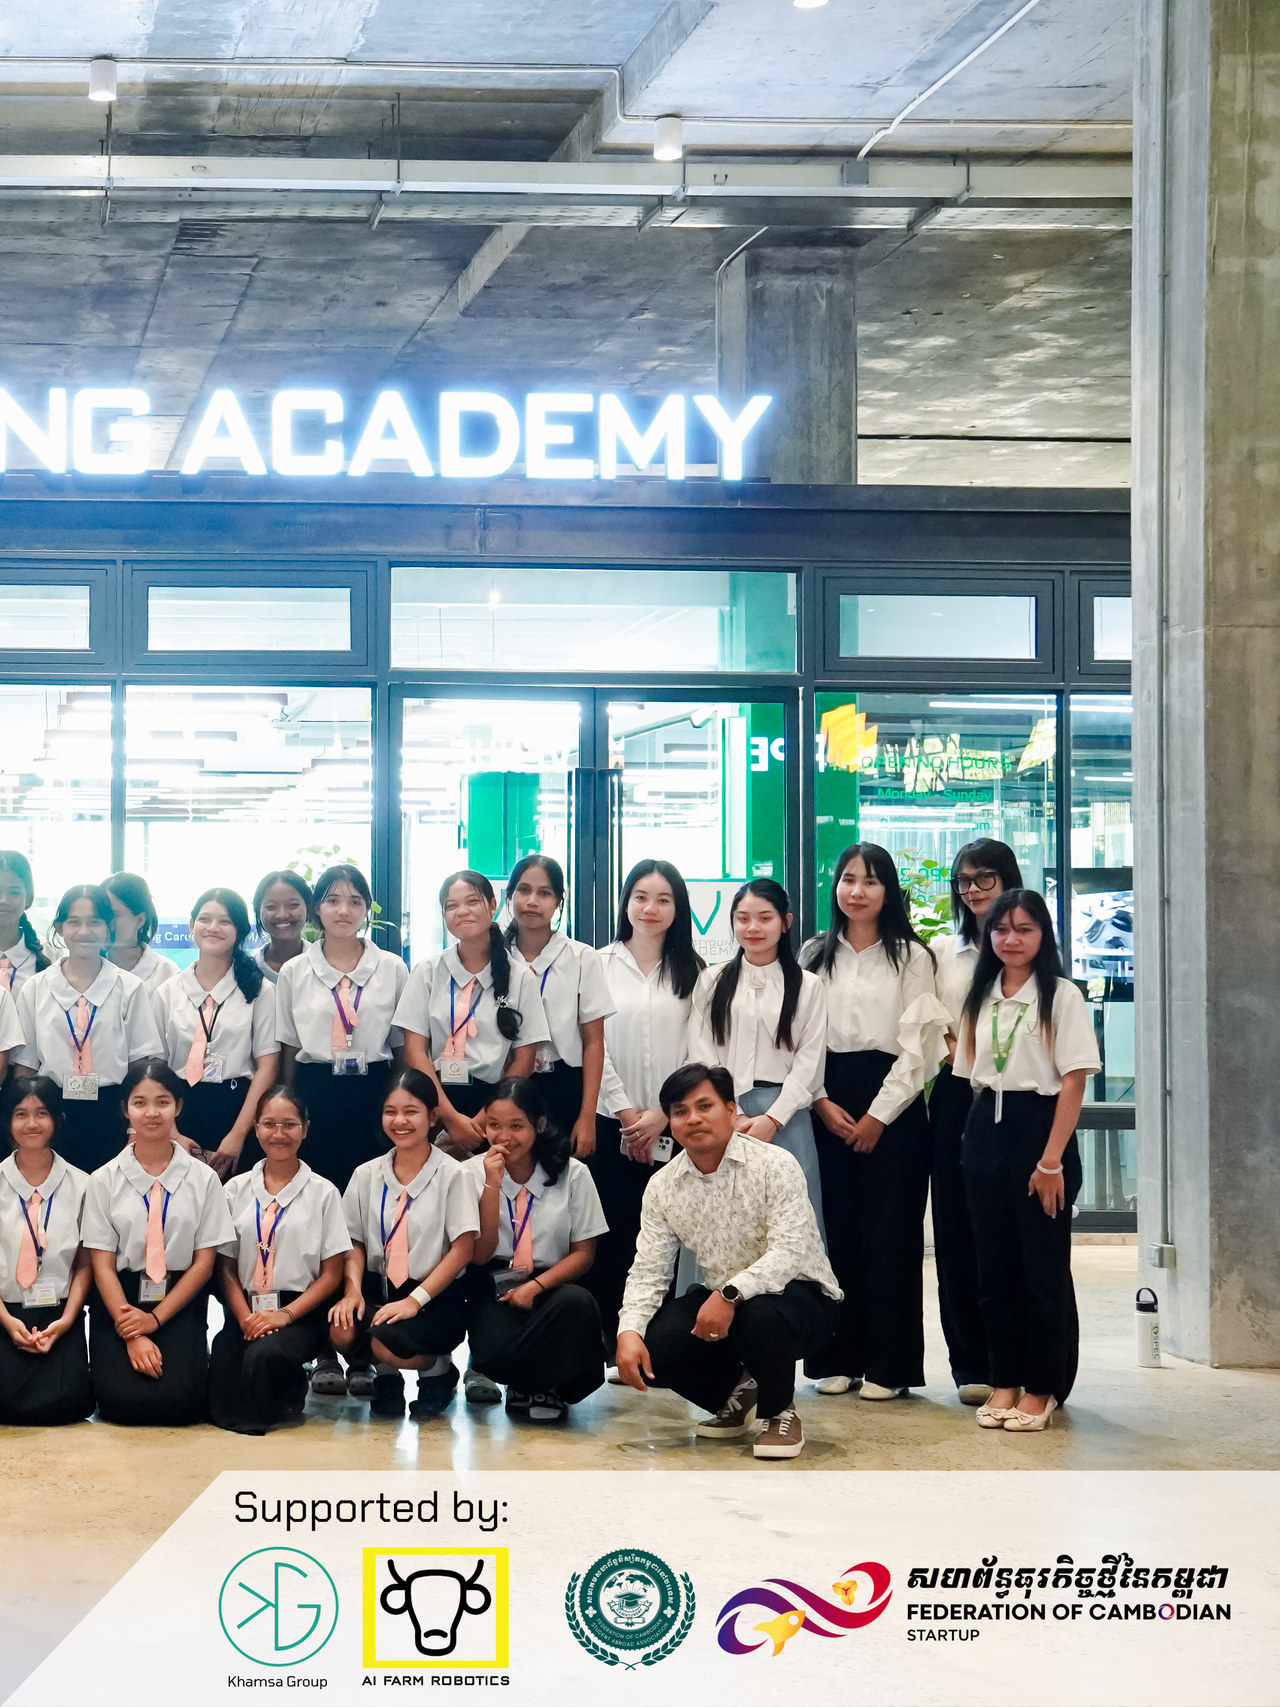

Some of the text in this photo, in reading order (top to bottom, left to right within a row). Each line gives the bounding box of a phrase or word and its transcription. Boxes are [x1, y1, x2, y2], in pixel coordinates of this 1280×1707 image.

[180, 388, 774, 482] ACADEMY
[861, 755, 1011, 770] OPENING HOURS
[877, 787, 931, 802] Monday
[944, 788, 992, 802] Sunday
